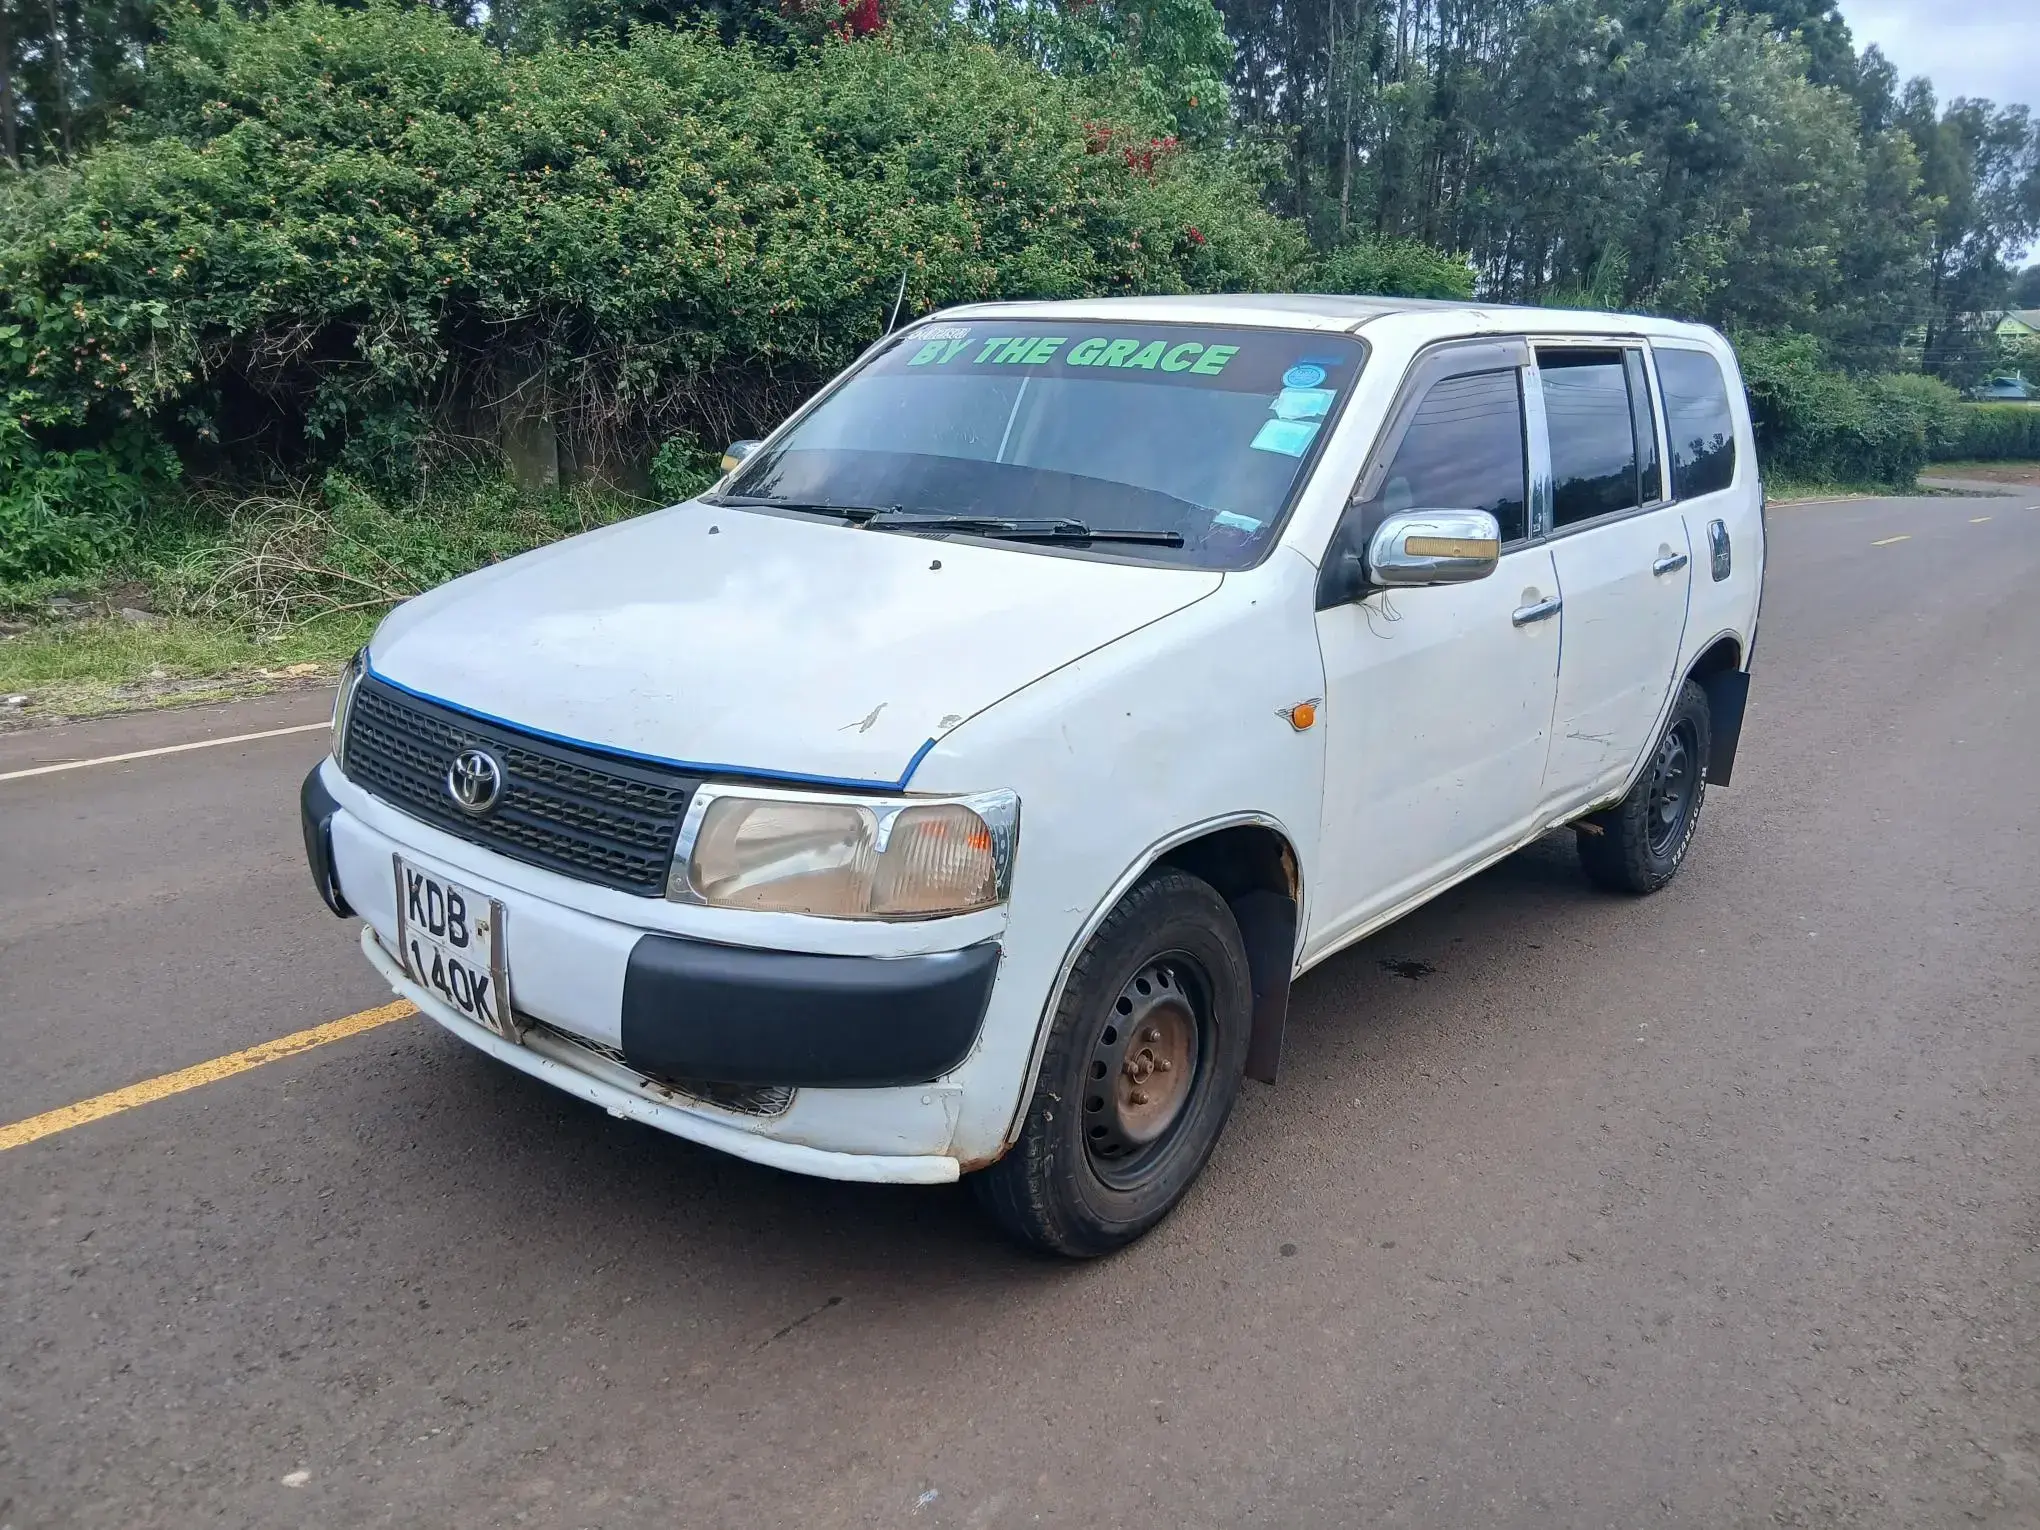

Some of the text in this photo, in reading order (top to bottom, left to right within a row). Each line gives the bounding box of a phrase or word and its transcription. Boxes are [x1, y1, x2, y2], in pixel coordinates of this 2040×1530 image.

[906, 336, 1241, 375] BY THE GRACE
[406, 868, 470, 949] KDB
[410, 939, 500, 1030] 140K
